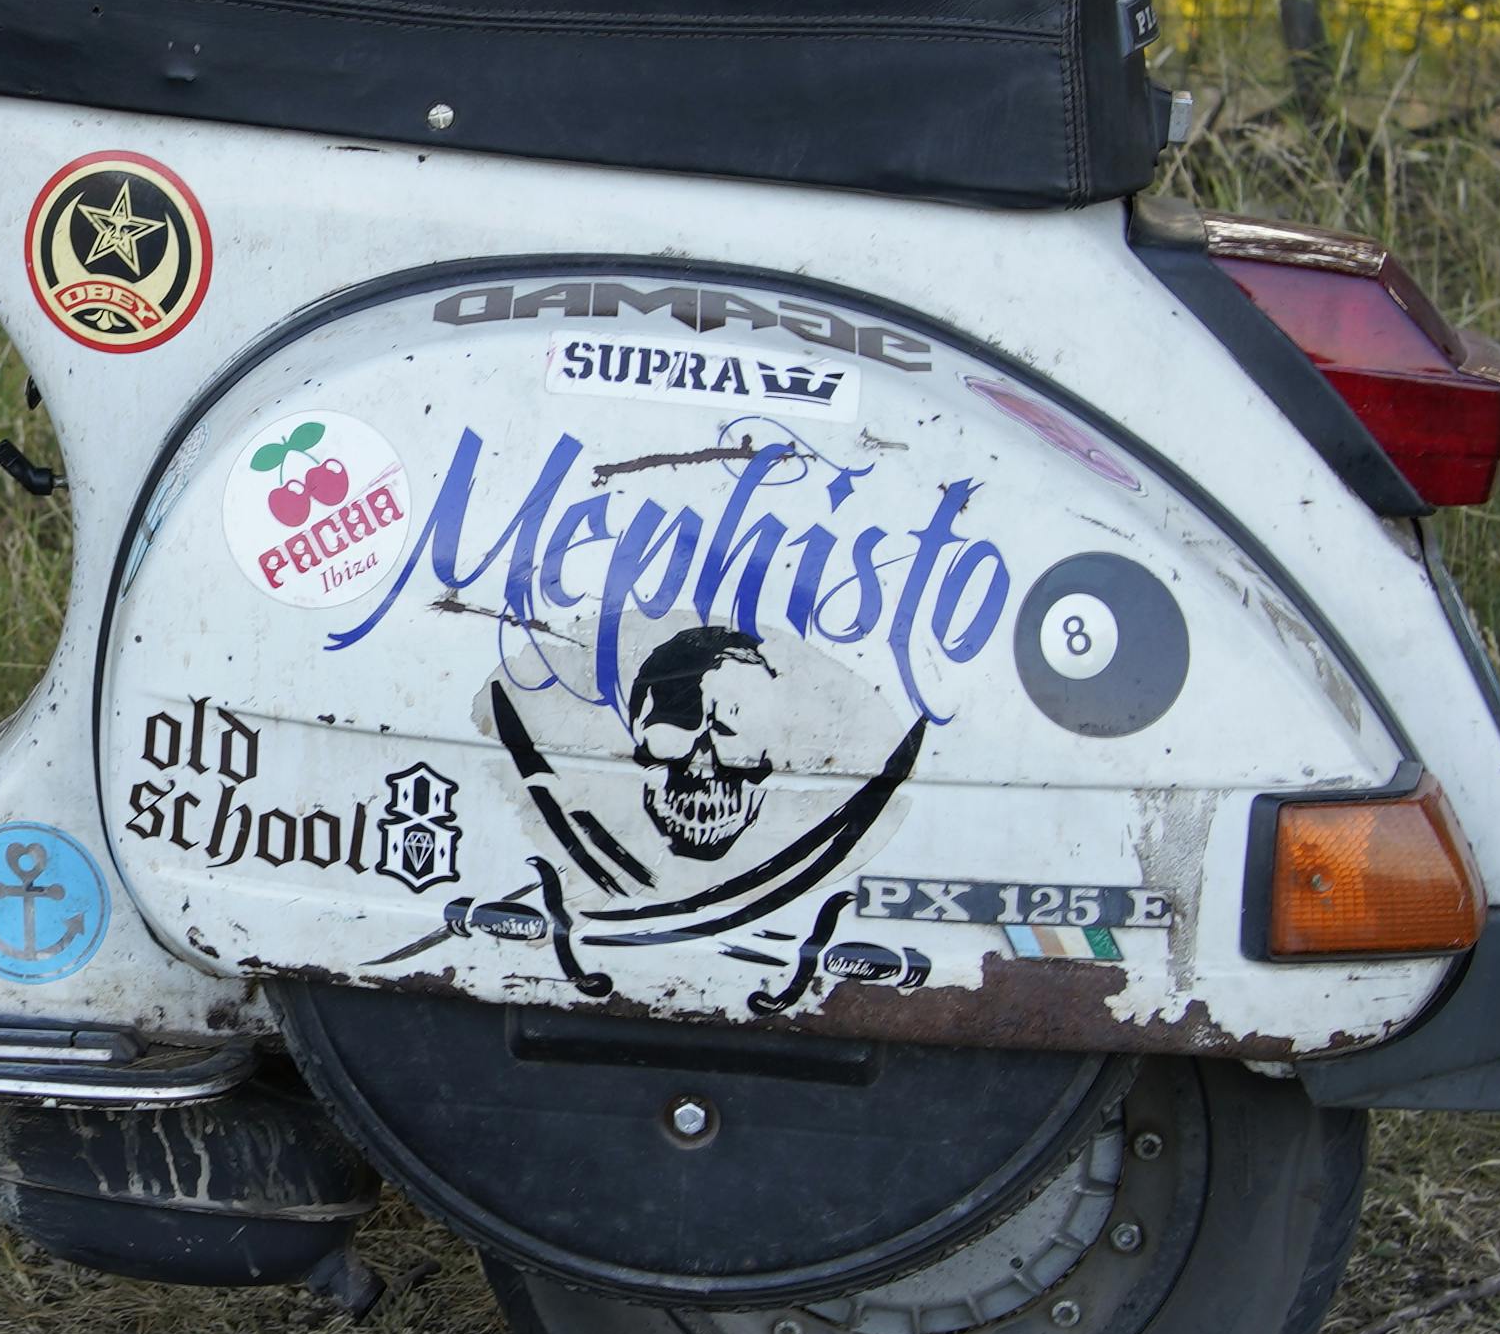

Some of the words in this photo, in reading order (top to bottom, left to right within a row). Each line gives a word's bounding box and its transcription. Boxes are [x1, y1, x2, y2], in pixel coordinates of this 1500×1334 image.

[59, 280, 162, 327] OBEY
[562, 341, 752, 396] SUPRA
[259, 484, 404, 589] PACHA
[319, 551, 380, 595] Ibiza
[323, 415, 1012, 744] Mephisto
[1062, 615, 1092, 657] 8
[142, 695, 261, 785] old
[126, 779, 369, 873] school
[861, 879, 971, 919] PX
[996, 885, 1101, 926] 125
[1124, 892, 1172, 927] E
